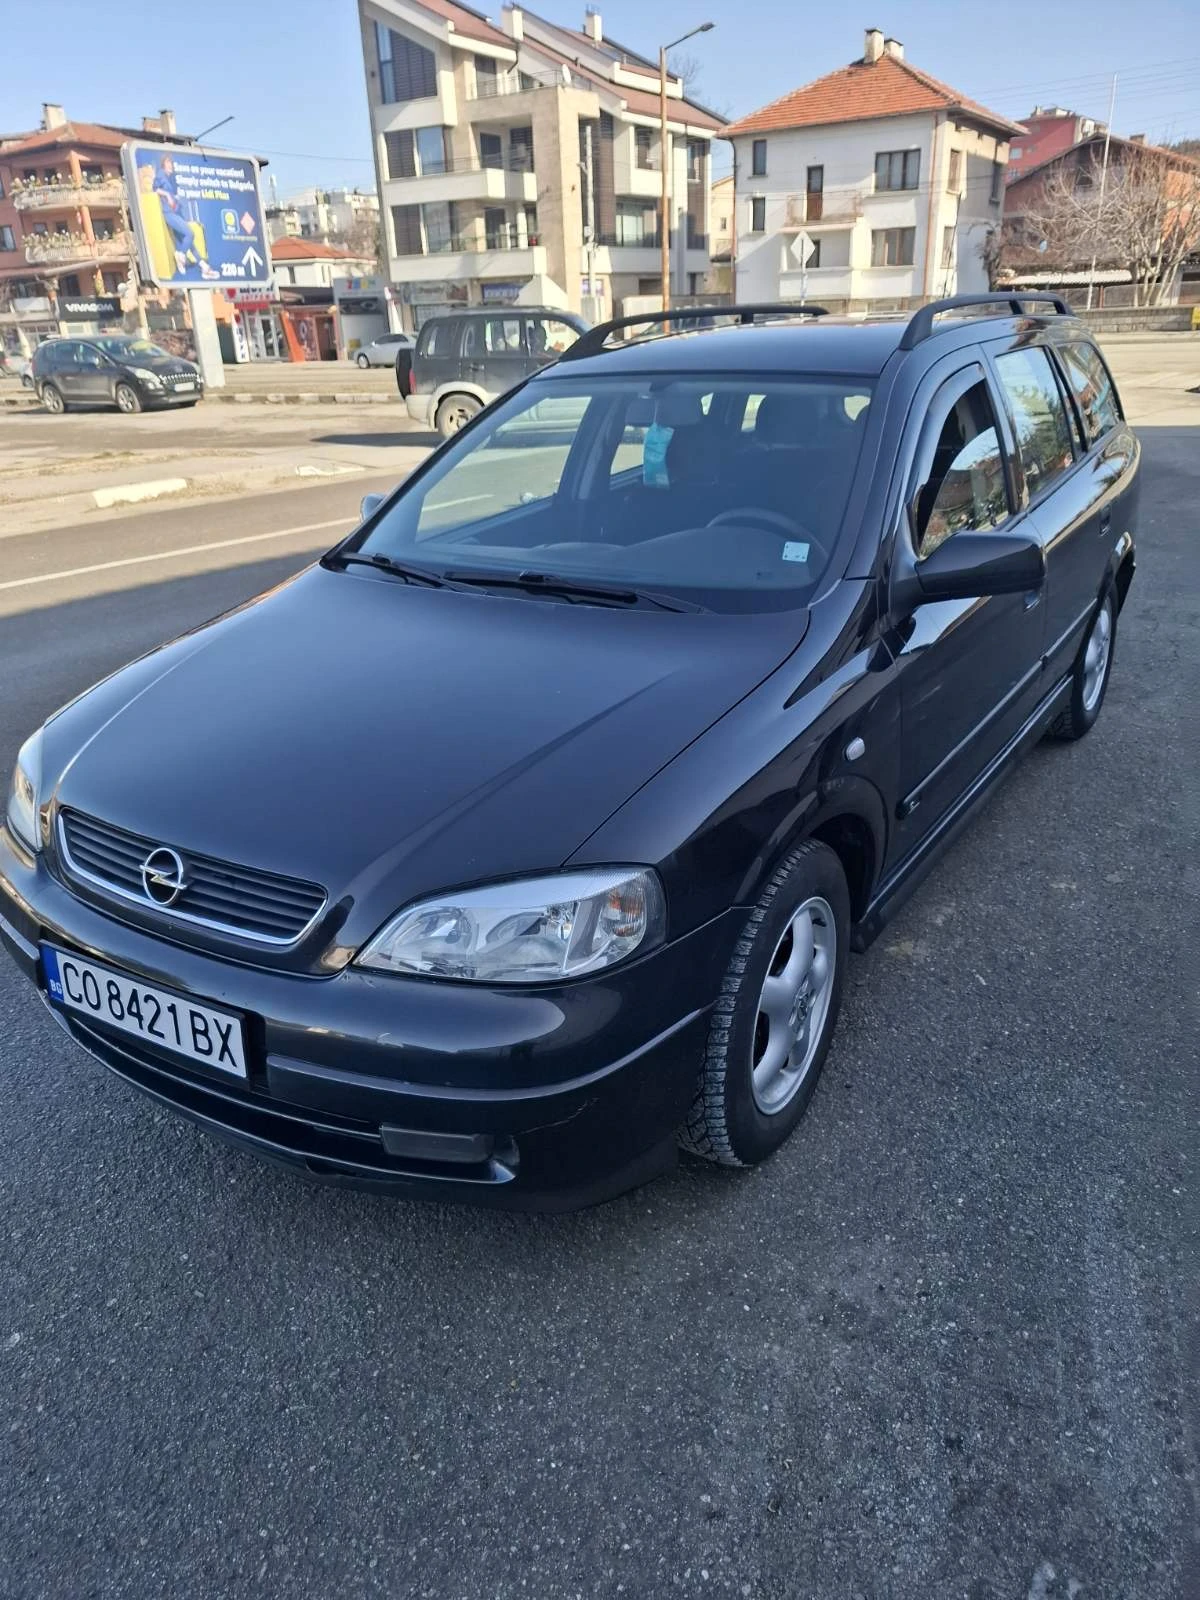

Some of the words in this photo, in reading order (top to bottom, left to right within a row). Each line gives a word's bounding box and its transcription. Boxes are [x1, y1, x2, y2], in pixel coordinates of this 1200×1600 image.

[200, 166, 215, 176] your
[64, 303, 114, 313] VIVACOM
[50, 978, 63, 994] BG
